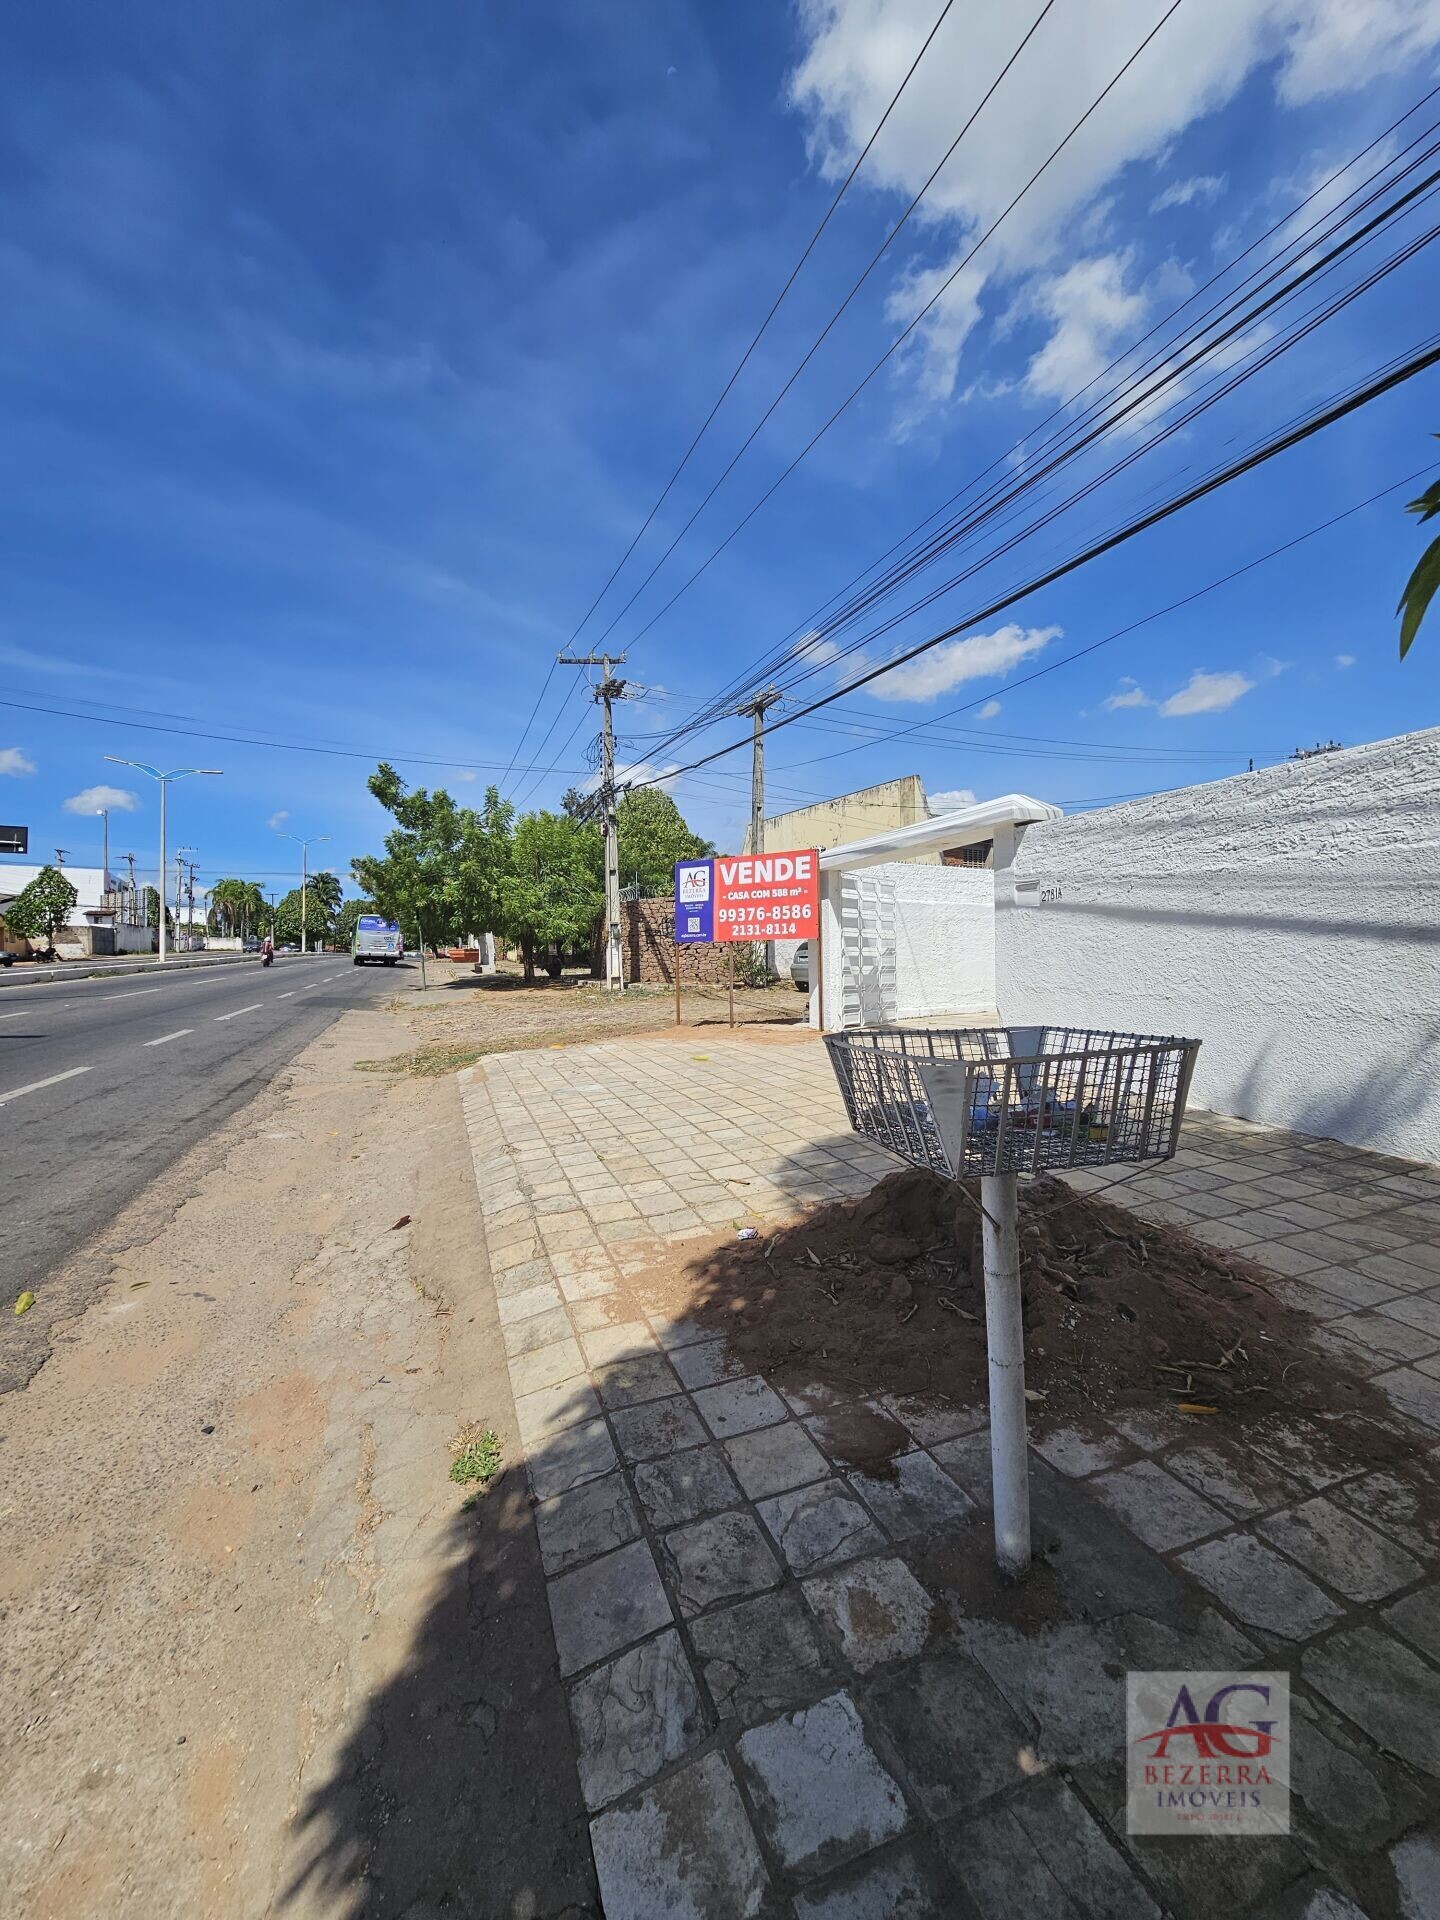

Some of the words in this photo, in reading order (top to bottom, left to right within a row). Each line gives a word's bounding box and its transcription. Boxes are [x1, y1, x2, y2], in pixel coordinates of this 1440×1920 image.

[720, 855, 811, 885] VENDE
[684, 870, 705, 888] AG
[728, 891, 749, 900] CASA
[751, 889, 770, 898] COM
[772, 888, 788, 897] 588
[1041, 887, 1062, 901] 2781A
[719, 904, 811, 922] 99376-8586
[732, 923, 796, 936] 2131-8114
